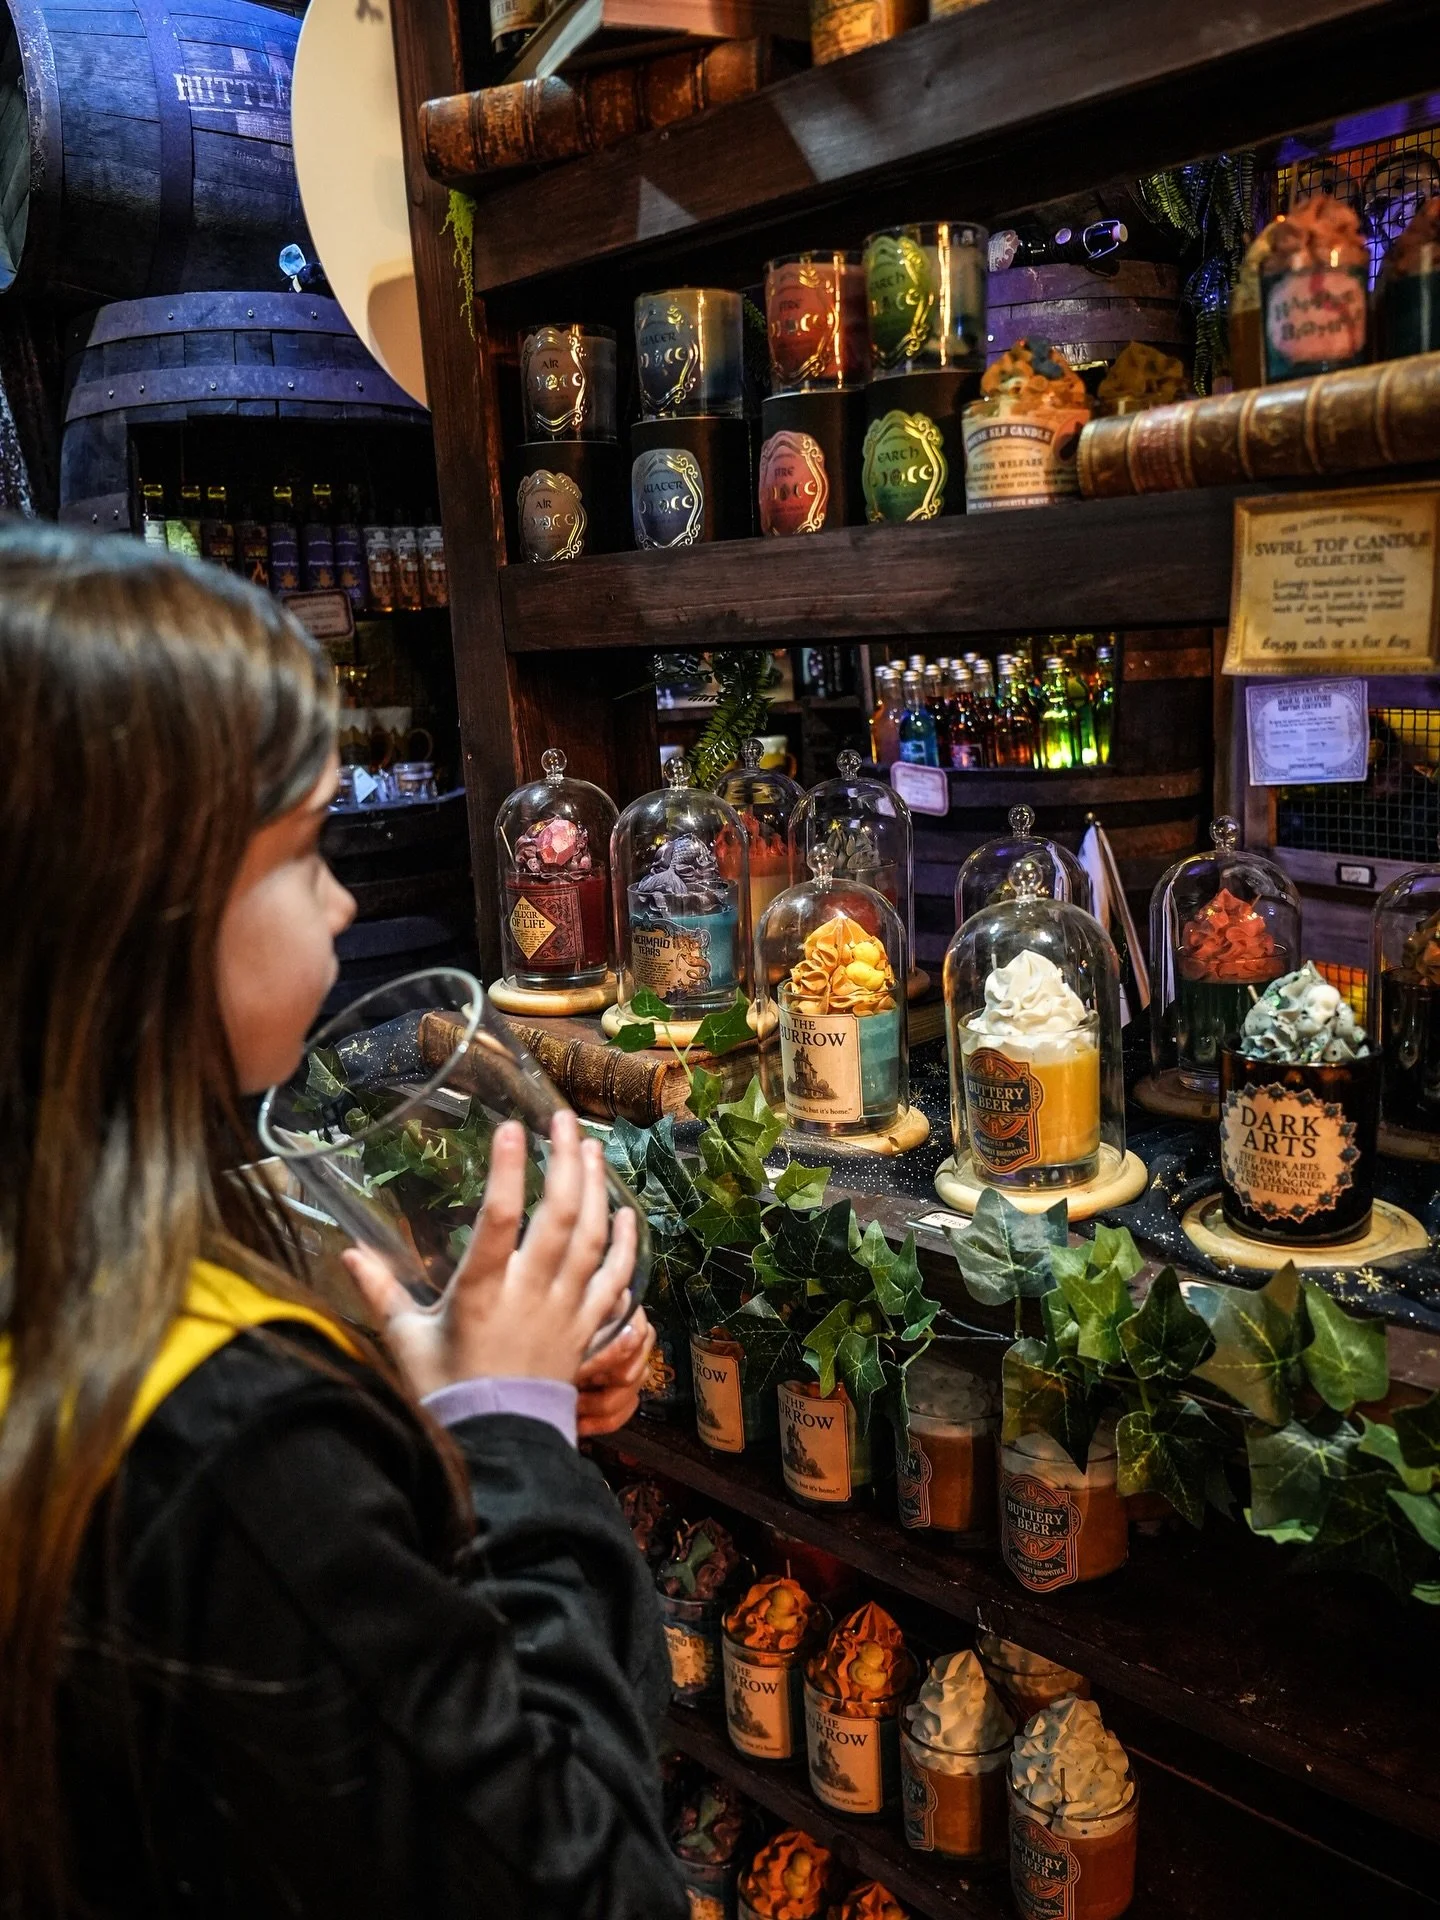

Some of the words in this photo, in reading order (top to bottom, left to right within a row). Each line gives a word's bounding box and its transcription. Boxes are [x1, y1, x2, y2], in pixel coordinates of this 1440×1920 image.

[541, 357, 559, 369] AIR
[1010, 425, 1051, 440] CANDLE
[877, 446, 920, 463] EARTH
[643, 480, 684, 494] WATER
[535, 499, 552, 509] AIR
[1254, 540, 1304, 557] SWIRL
[1312, 536, 1349, 553] TOP
[1353, 530, 1431, 550] CANDLE
[511, 917, 521, 928] OF
[523, 919, 546, 929] LIFE
[514, 911, 539, 919] ELIXIR
[791, 1017, 817, 1031] THE
[967, 1078, 1025, 1101] BUTTERY
[977, 1095, 1011, 1113] BEER
[1240, 1104, 1321, 1137] DARK
[1242, 1127, 1317, 1159] ARTS
[1240, 1150, 1257, 1162] THE
[1260, 1156, 1288, 1169] DARK
[1292, 1163, 1320, 1171] ARTS
[1241, 1175, 1260, 1188] AND
[785, 1396, 806, 1411] THE
[1007, 1500, 1064, 1526] BUTTERY
[1017, 1516, 1051, 1536] BEER
[816, 1712, 839, 1729] THE
